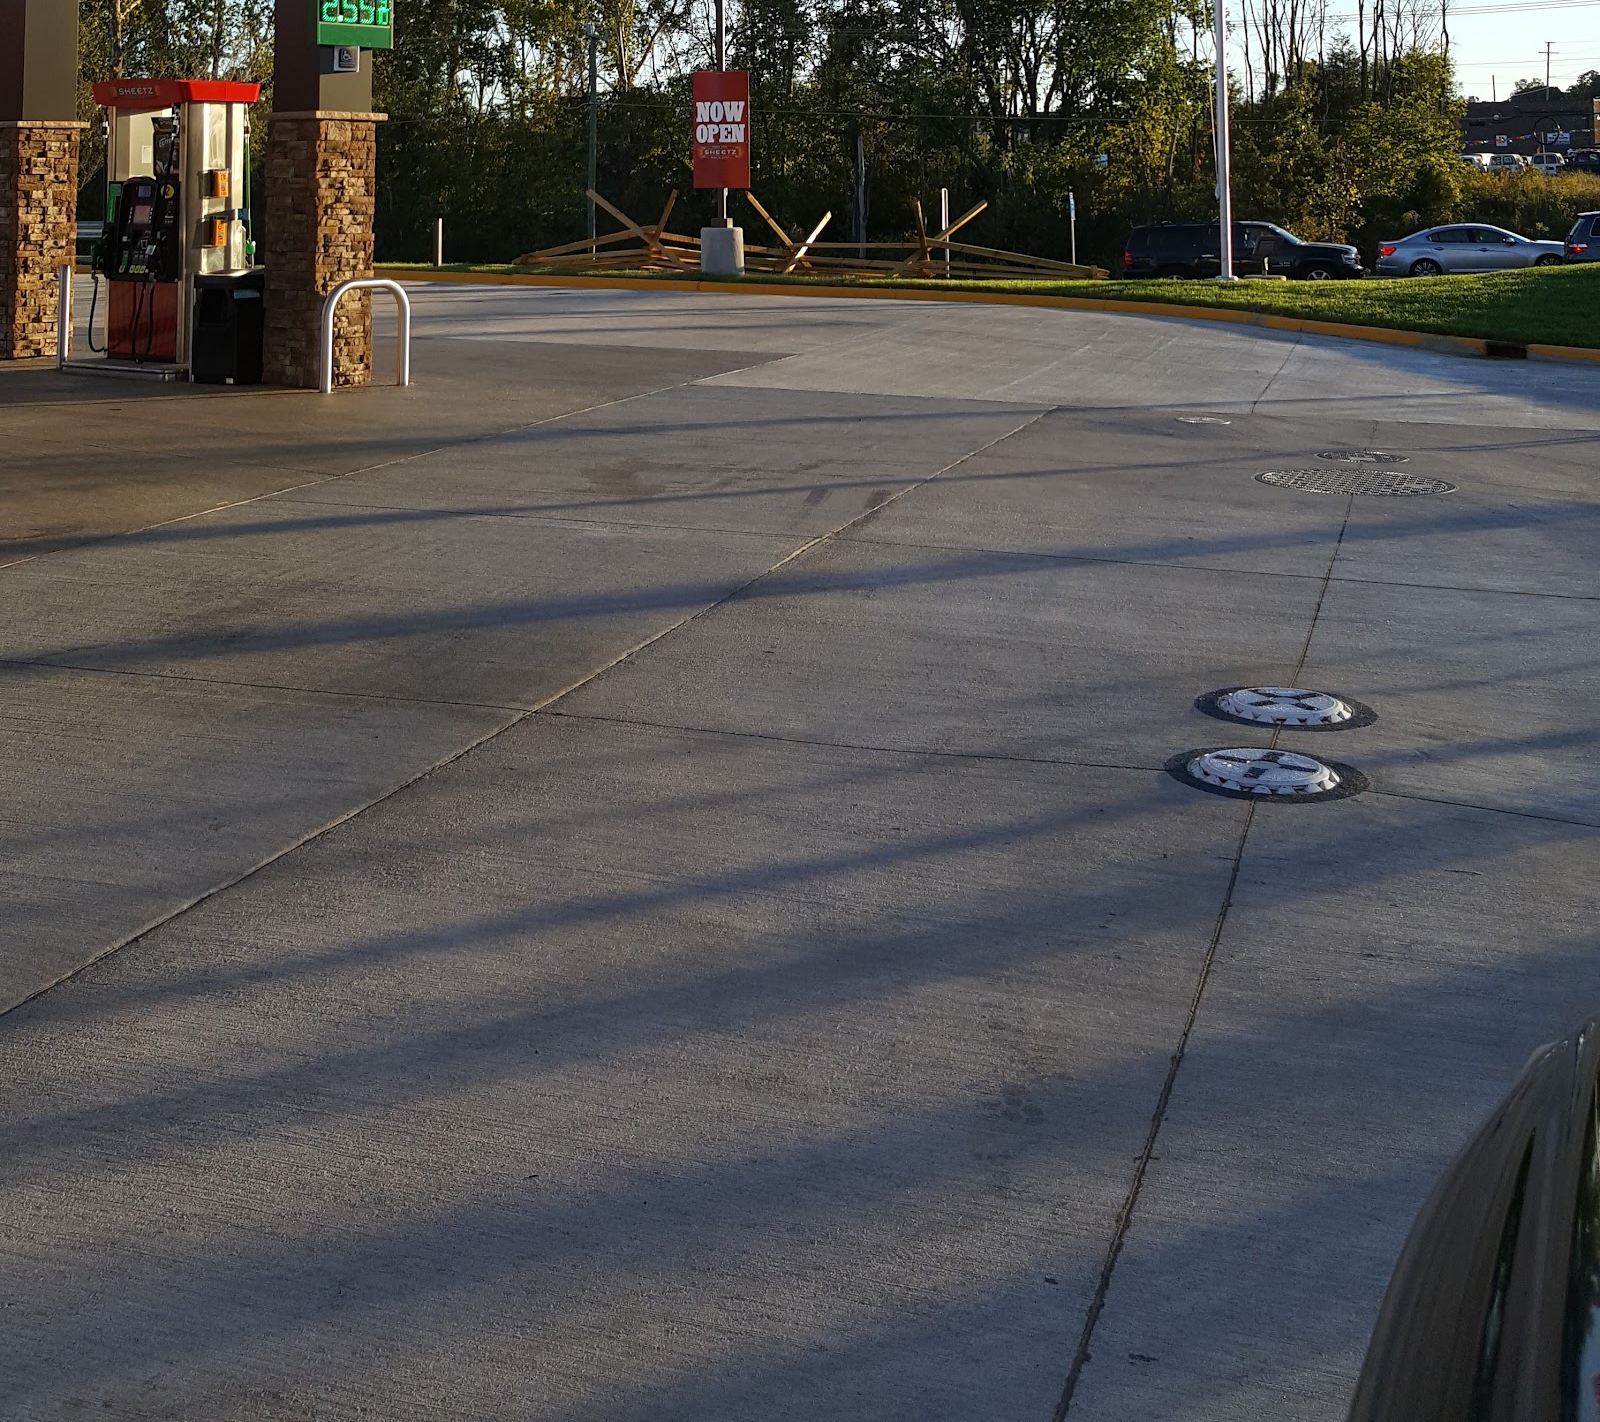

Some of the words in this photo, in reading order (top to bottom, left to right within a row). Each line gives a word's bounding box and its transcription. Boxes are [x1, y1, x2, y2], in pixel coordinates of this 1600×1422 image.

[118, 87, 153, 95] SHEETZ
[696, 101, 745, 122] NOW
[696, 124, 745, 143] OPEN
